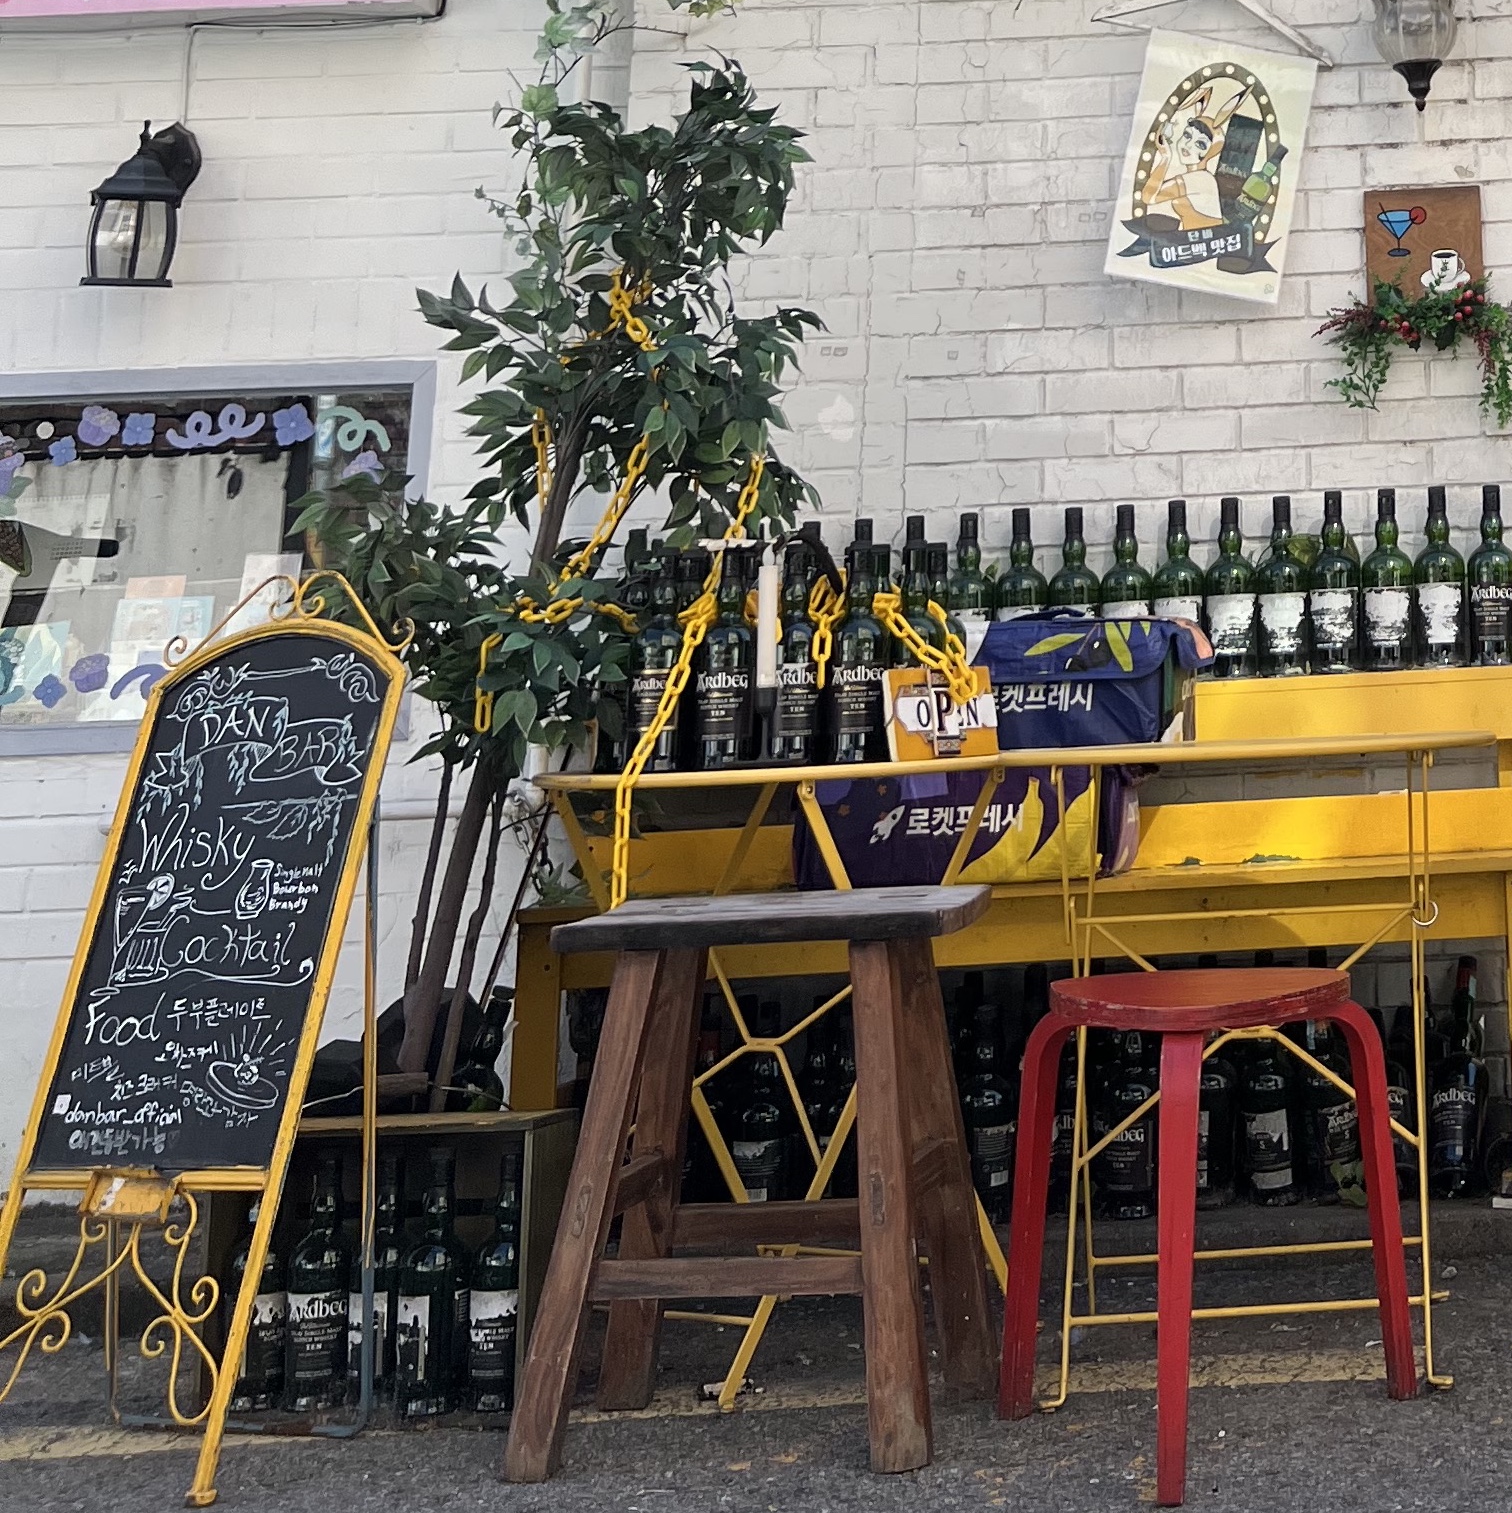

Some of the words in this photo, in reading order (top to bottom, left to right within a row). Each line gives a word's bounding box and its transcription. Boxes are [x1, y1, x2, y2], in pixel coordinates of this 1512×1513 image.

[1210, 233, 1242, 256] 맛집
[199, 706, 270, 746] DAN
[273, 725, 342, 773] BAR
[138, 803, 256, 891] Whisky
[268, 897, 309, 914] Brandy
[159, 915, 297, 968] Cocktail
[85, 991, 167, 1046] Food
